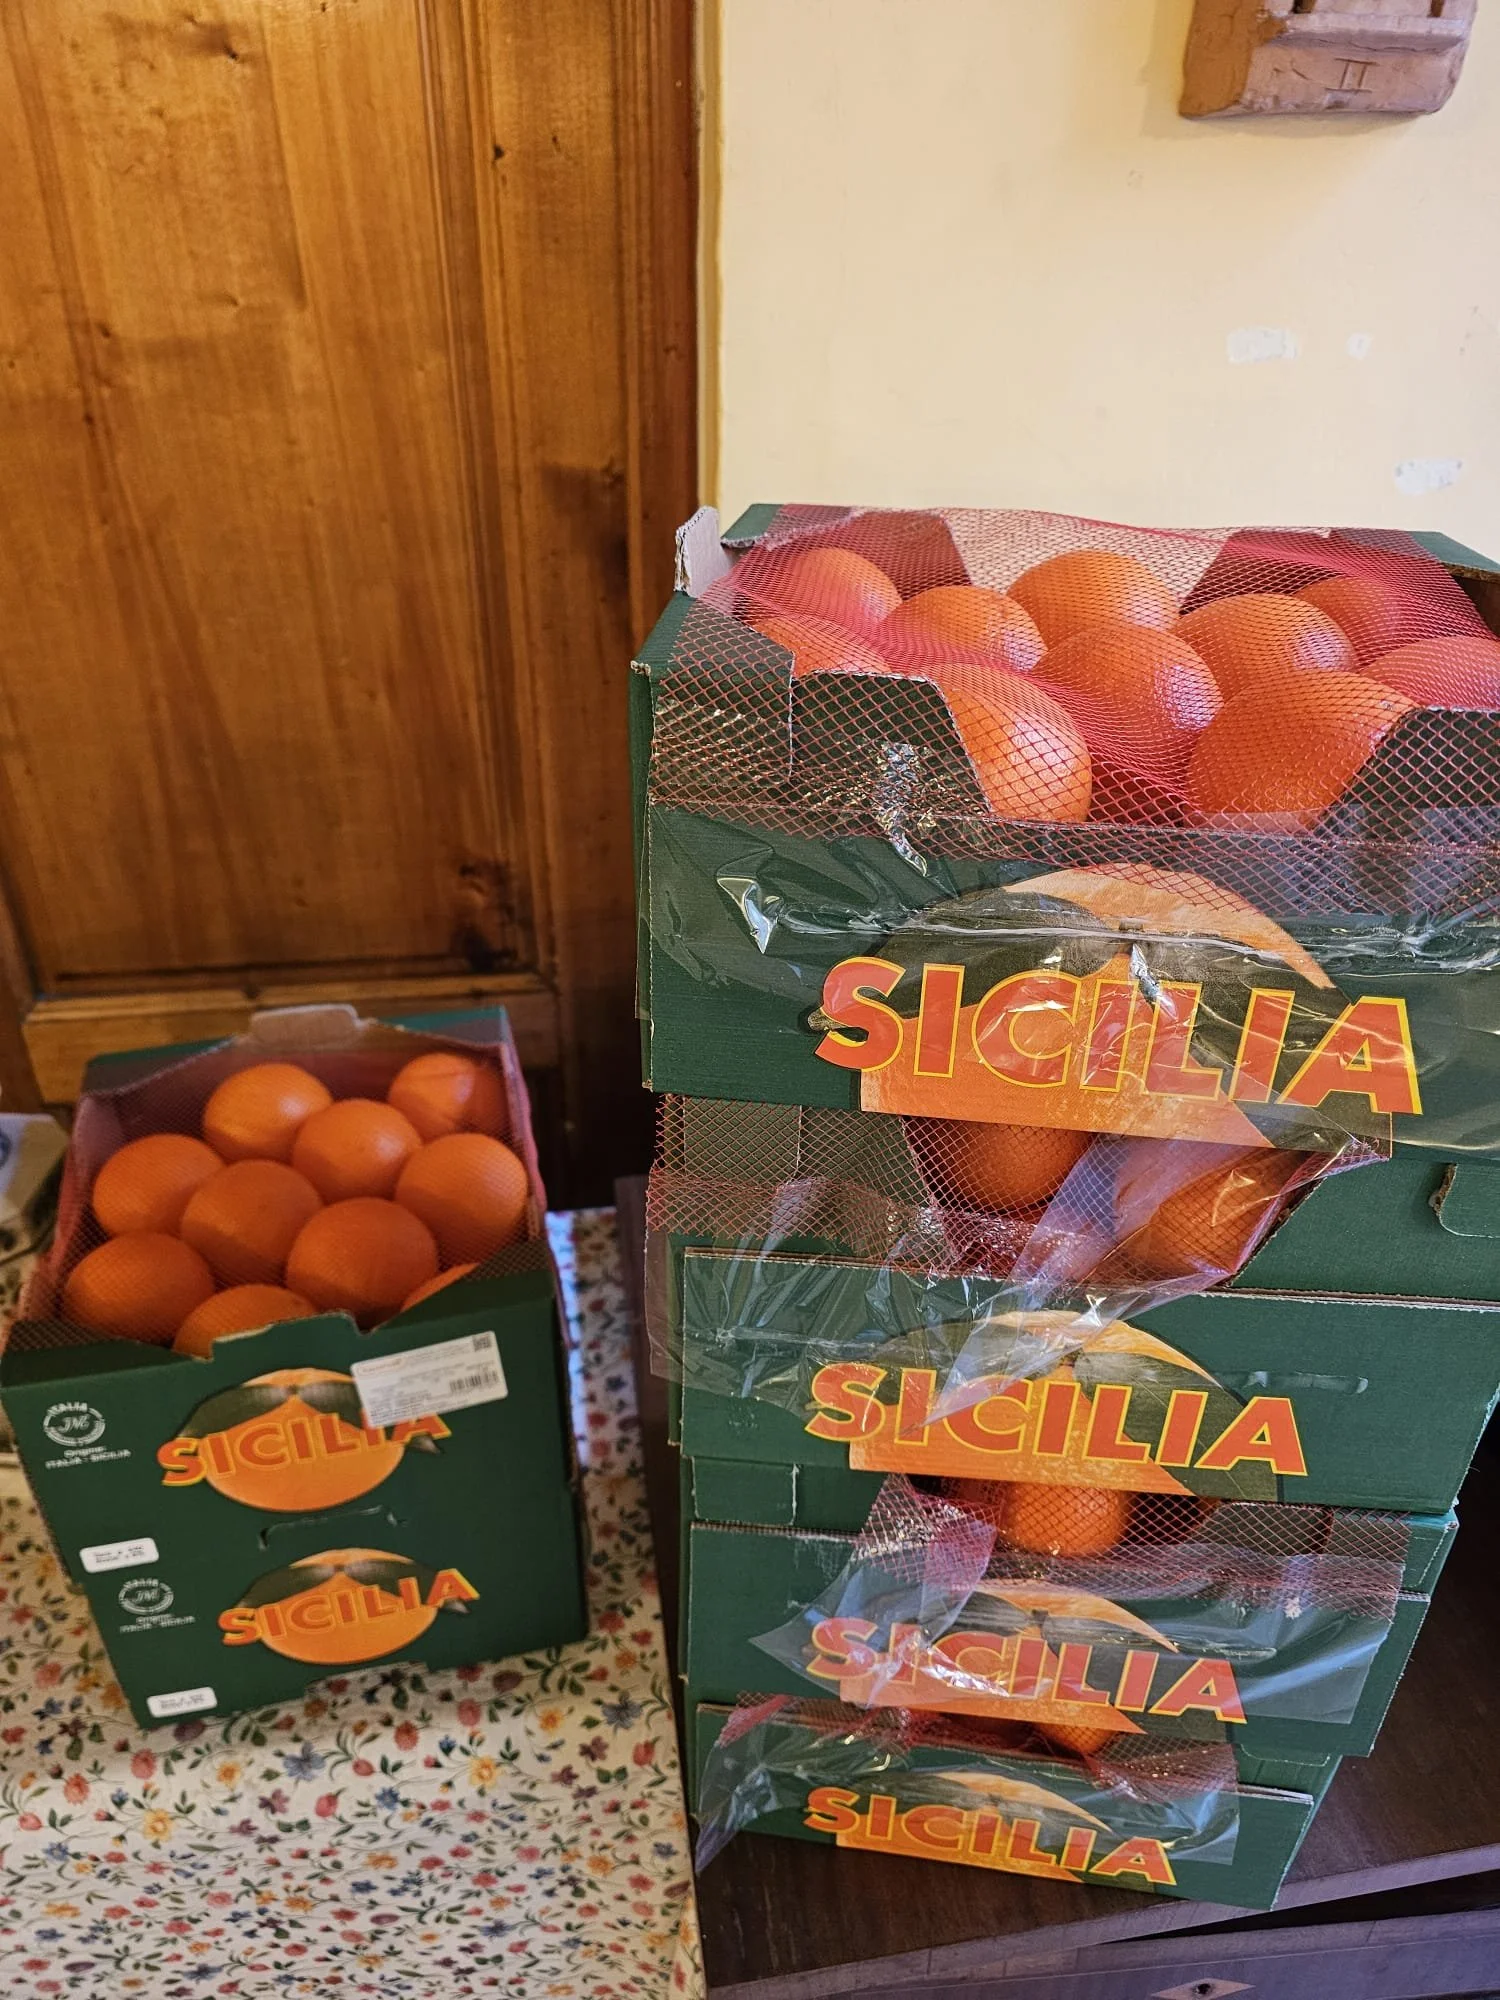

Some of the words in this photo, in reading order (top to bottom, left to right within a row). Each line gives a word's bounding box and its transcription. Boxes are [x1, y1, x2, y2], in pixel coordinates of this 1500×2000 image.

[813, 955, 1424, 1116] SICILIA
[157, 1408, 452, 1486] SICILIA
[805, 1362, 1308, 1477] SICILIA
[218, 1568, 480, 1645] SICILIA
[806, 1618, 1247, 1725] SICILIA
[804, 1786, 1178, 1886] SICILIA
